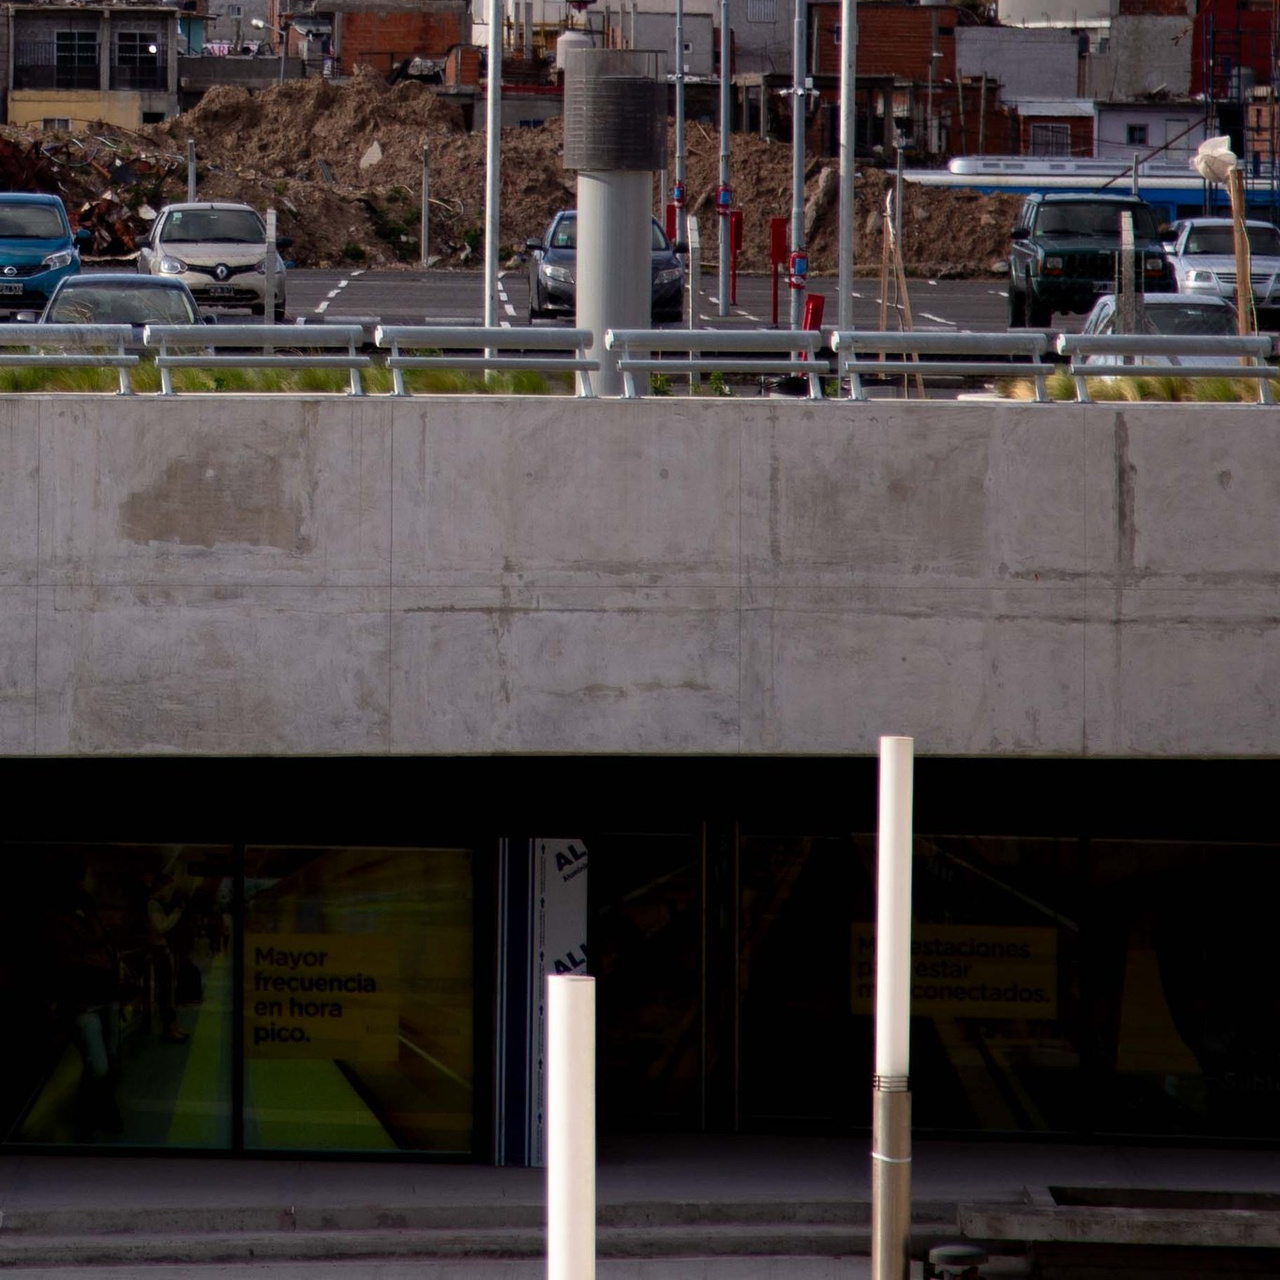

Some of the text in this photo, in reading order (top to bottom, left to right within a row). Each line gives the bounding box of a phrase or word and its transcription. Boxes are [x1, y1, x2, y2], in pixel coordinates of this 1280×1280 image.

[254, 946, 328, 970] Mayor
[911, 937, 1031, 959] estaciones
[914, 960, 973, 979] estar
[254, 971, 377, 993] frecuencia
[911, 982, 1051, 1004] conectados.
[254, 997, 343, 1017] en hora
[253, 1022, 312, 1045] pico.
